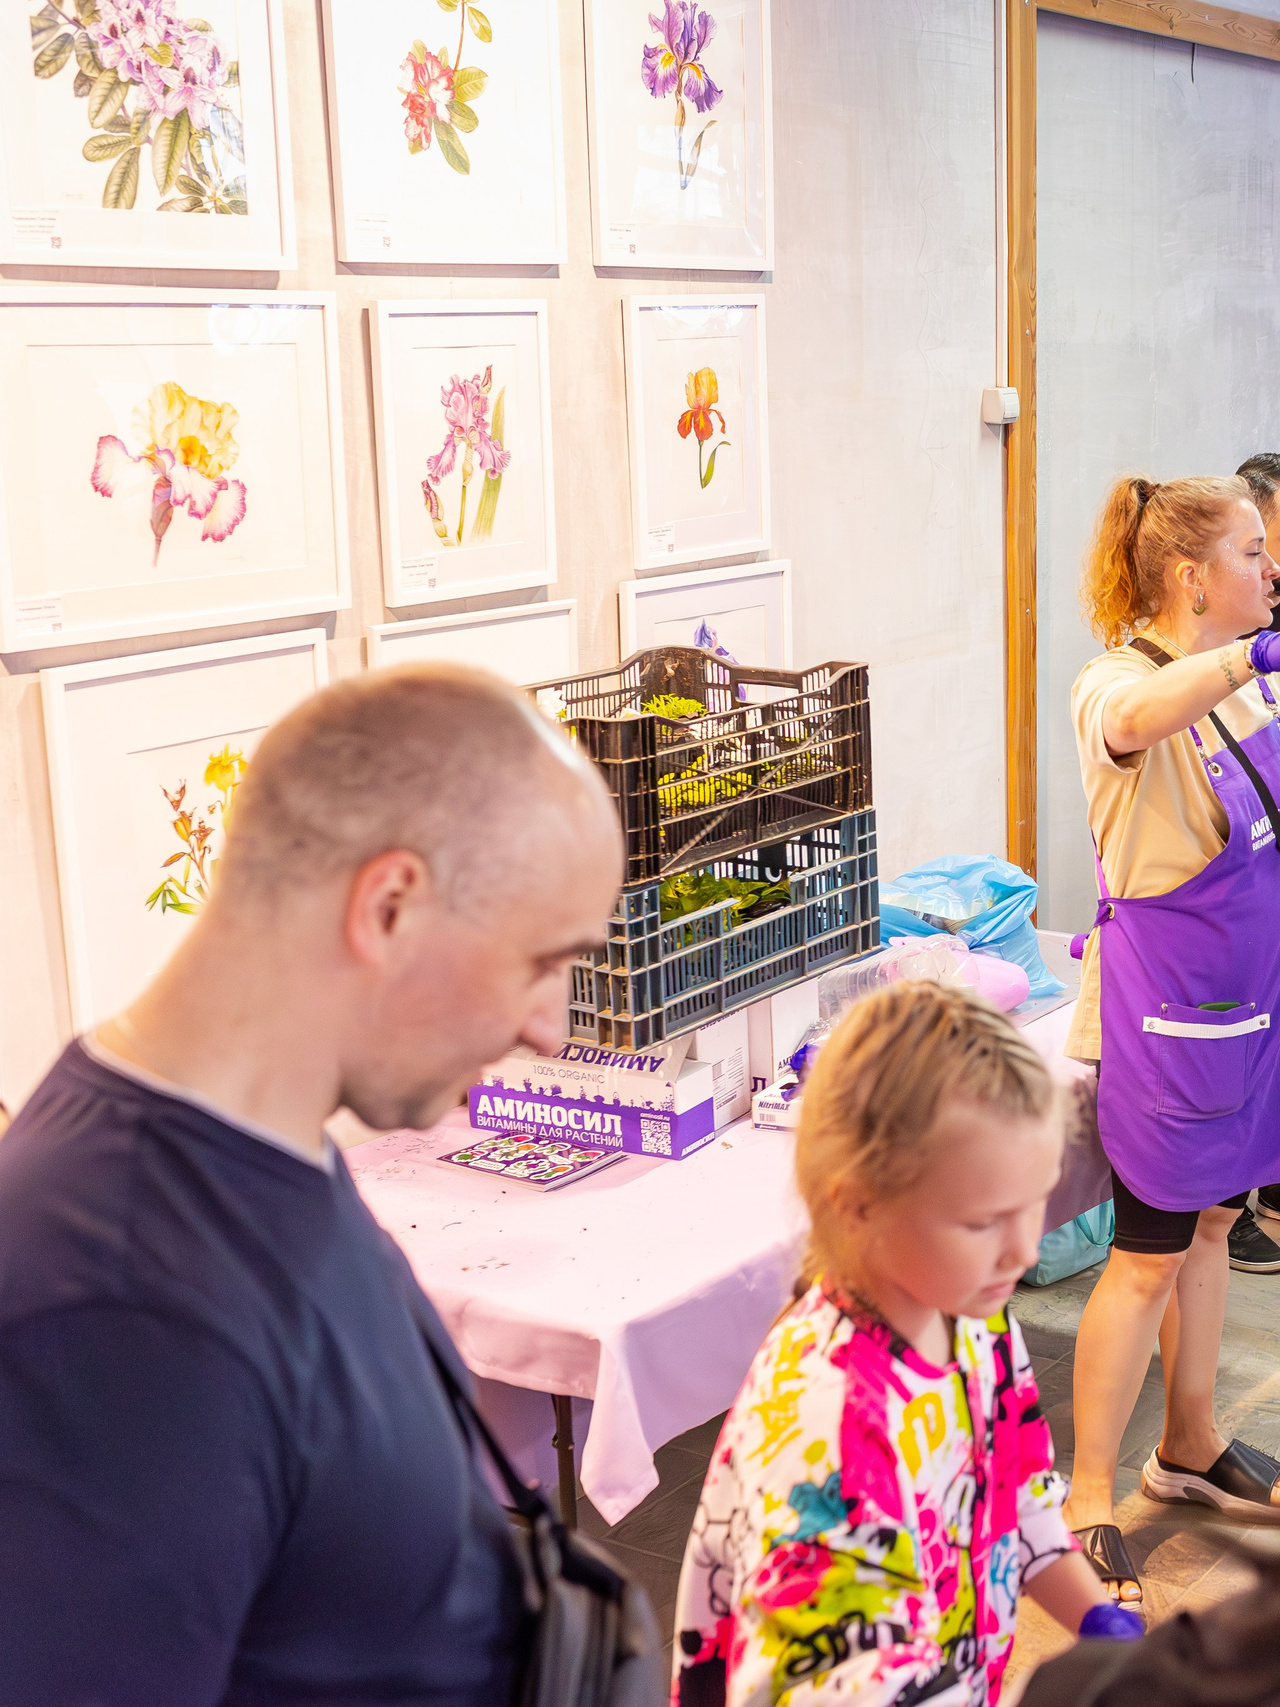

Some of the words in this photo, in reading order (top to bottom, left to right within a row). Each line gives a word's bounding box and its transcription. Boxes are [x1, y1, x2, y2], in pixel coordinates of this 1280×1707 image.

[533, 1064, 556, 1077] 100%
[559, 1068, 606, 1084] ORGANIC
[476, 1094, 622, 1136] АМИНОСИЛ
[477, 1115, 537, 1139] ВИТАМИНЫ
[538, 1125, 564, 1141] ДЛЯ
[564, 1129, 624, 1148] РАСТЕНИЙ
